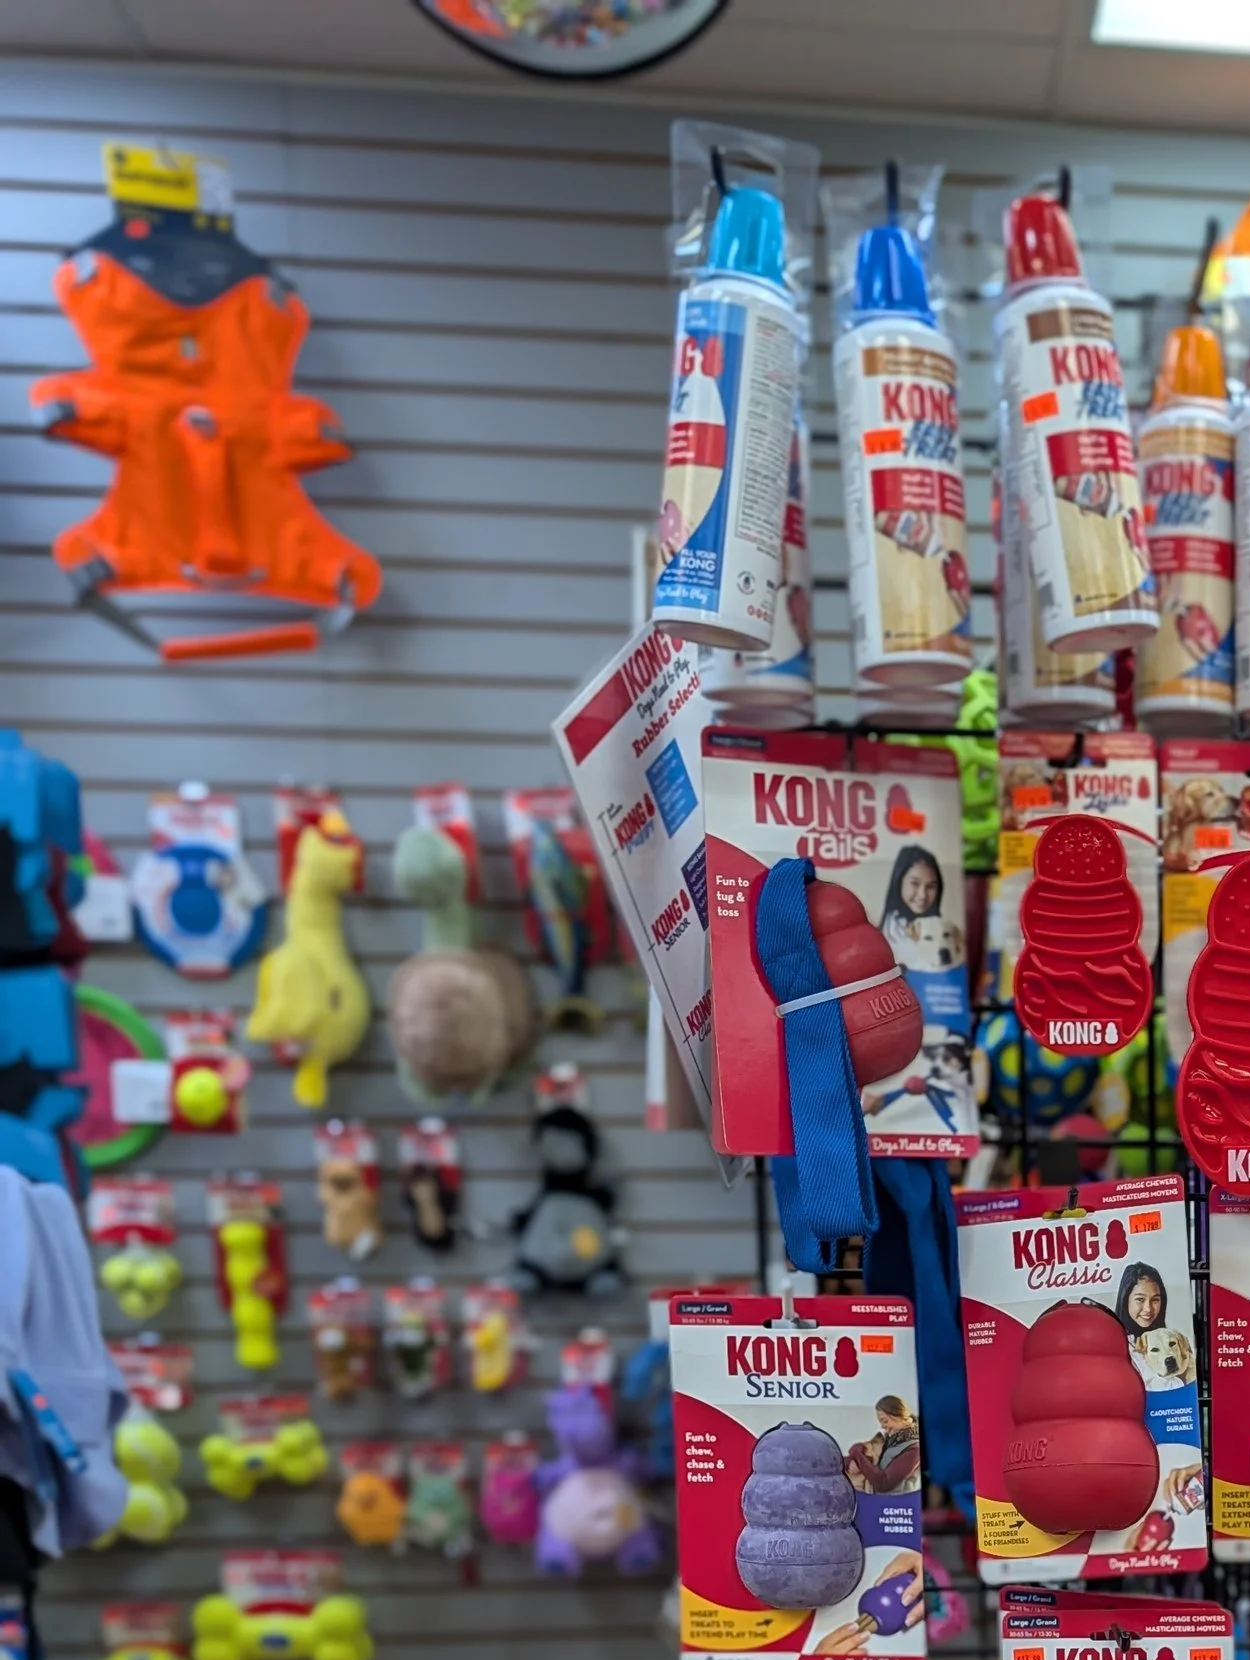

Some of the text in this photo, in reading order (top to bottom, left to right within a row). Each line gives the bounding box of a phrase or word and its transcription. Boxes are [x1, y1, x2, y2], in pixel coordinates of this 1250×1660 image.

[680, 558, 715, 571] KONG
[623, 627, 672, 700] KONG
[633, 713, 669, 758] Rubber
[668, 672, 700, 717] Selecti
[1074, 774, 1132, 798] KONG
[754, 773, 876, 834] KONG
[613, 800, 649, 850] KONG
[802, 831, 870, 861] Tails
[716, 876, 749, 887] Fun to
[717, 891, 745, 904] tug &
[718, 906, 739, 917] toss
[652, 898, 682, 945] KONG
[664, 918, 691, 951] SENIOR
[870, 988, 911, 1019] KONG
[1048, 1020, 1102, 1045] KONG
[1116, 1178, 1177, 1191] AVERAGE CHEWERS
[1103, 1189, 1178, 1202] MASTICATEURS MOYENS
[1012, 1223, 1100, 1269] KONG
[1027, 1263, 1113, 1290] Classic
[1217, 1318, 1248, 1328] Fun to
[1217, 1332, 1244, 1342] chew,
[1217, 1345, 1244, 1354] chase
[727, 1336, 827, 1378] KONG
[1217, 1357, 1243, 1368] fetch
[746, 1374, 840, 1399] SENIOR
[1150, 1408, 1192, 1417] CAOUTCHOUC
[1167, 1416, 1193, 1424] NATUREL
[1167, 1424, 1193, 1432] DURABLE
[686, 1432, 717, 1443] Fun to
[686, 1447, 714, 1457] chew,
[1006, 1437, 1048, 1464] KONG
[687, 1459, 725, 1470] chase &
[688, 1472, 713, 1483] fetch
[883, 1508, 913, 1517] GENTLE
[879, 1517, 913, 1525] NATURAL
[885, 1526, 913, 1534] RUBBER
[1159, 1615, 1225, 1623] AVERAGE CHEWERS
